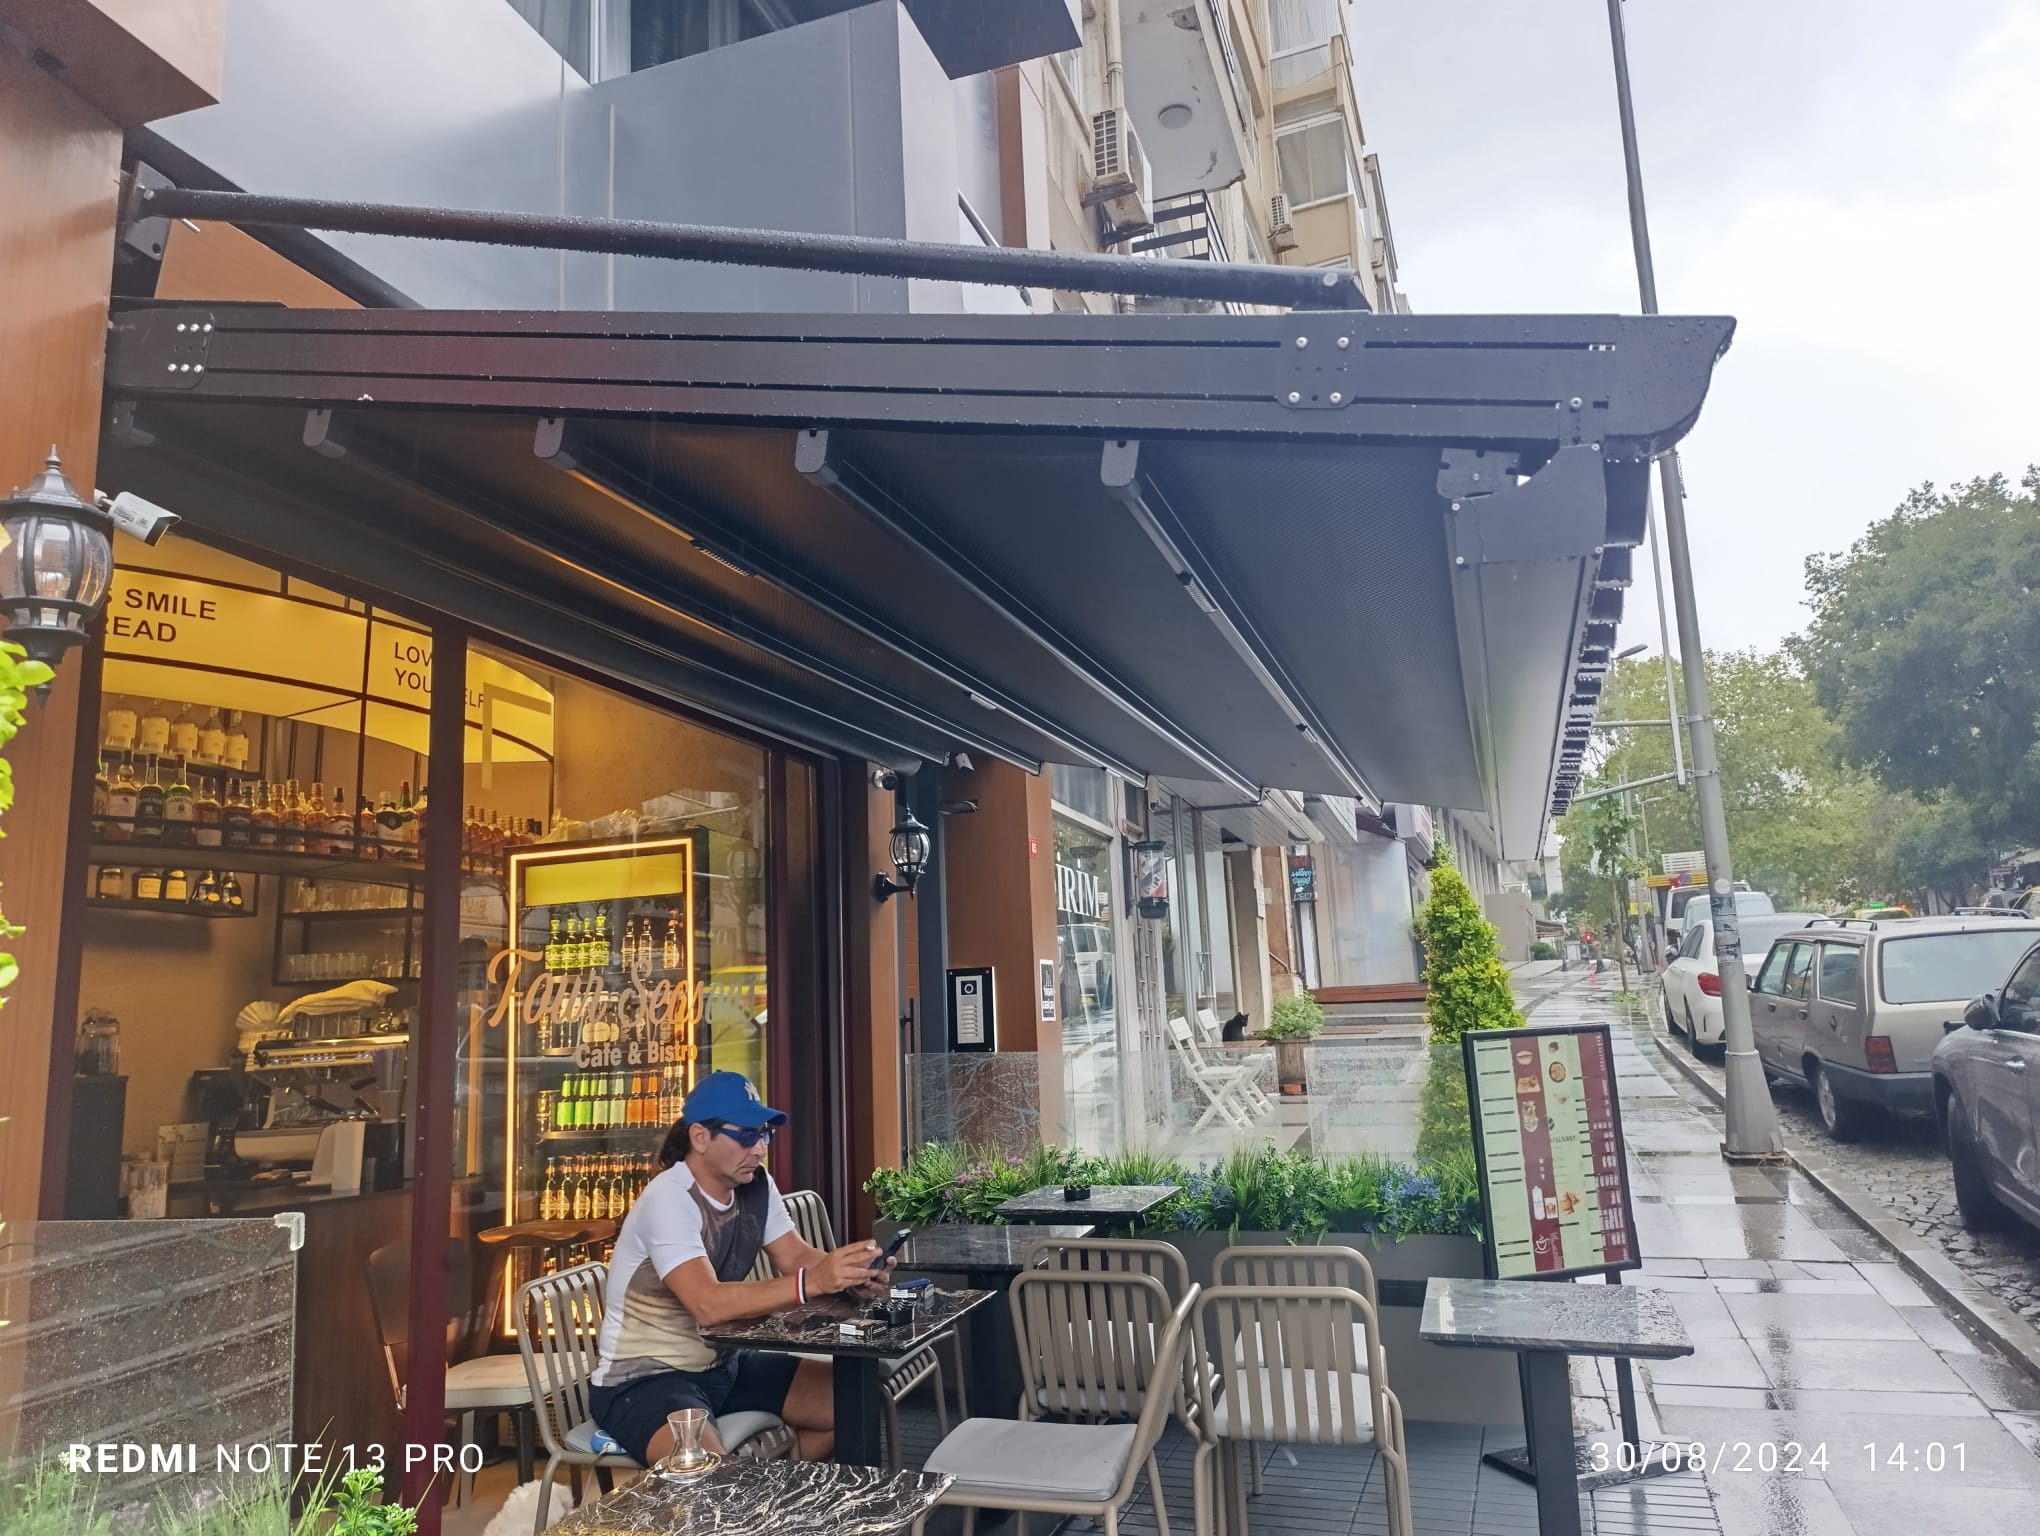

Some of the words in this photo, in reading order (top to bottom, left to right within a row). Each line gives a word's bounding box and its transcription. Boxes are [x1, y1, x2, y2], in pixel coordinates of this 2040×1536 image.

[125, 588, 217, 621] SMILE
[105, 615, 177, 643] EAD
[394, 641, 432, 667] LOV
[487, 949, 606, 1028] Four
[575, 1043, 622, 1068] Cafe
[628, 1041, 642, 1065] &
[647, 1039, 698, 1064] Bistro
